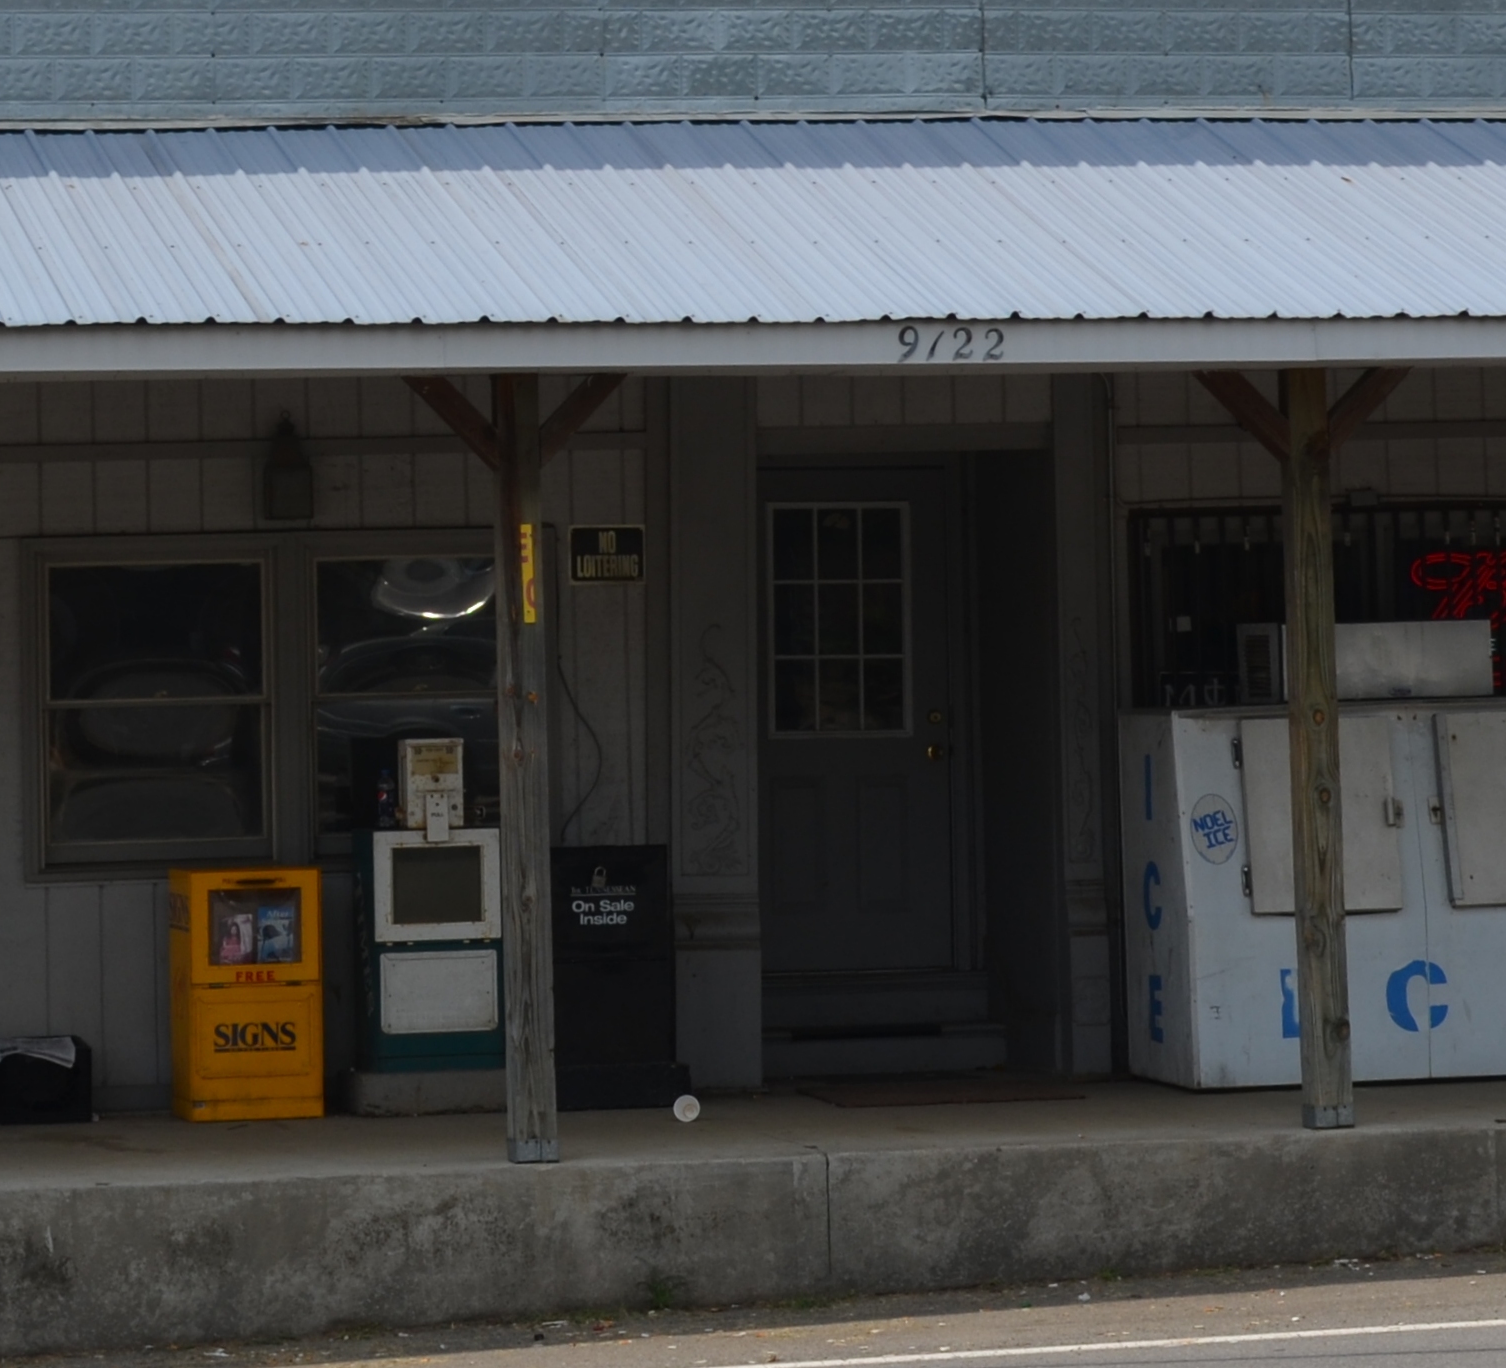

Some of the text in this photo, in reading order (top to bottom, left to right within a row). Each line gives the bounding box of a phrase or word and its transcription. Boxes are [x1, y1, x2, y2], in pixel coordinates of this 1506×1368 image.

[598, 530, 616, 553] NO
[576, 554, 639, 578] LOITERING
[1192, 809, 1234, 833] NOEL
[1203, 825, 1235, 849] ICE
[572, 899, 635, 913] On Sale
[579, 912, 628, 926] Inside
[235, 970, 276, 982] FREE
[213, 1021, 297, 1047] SIGNS
